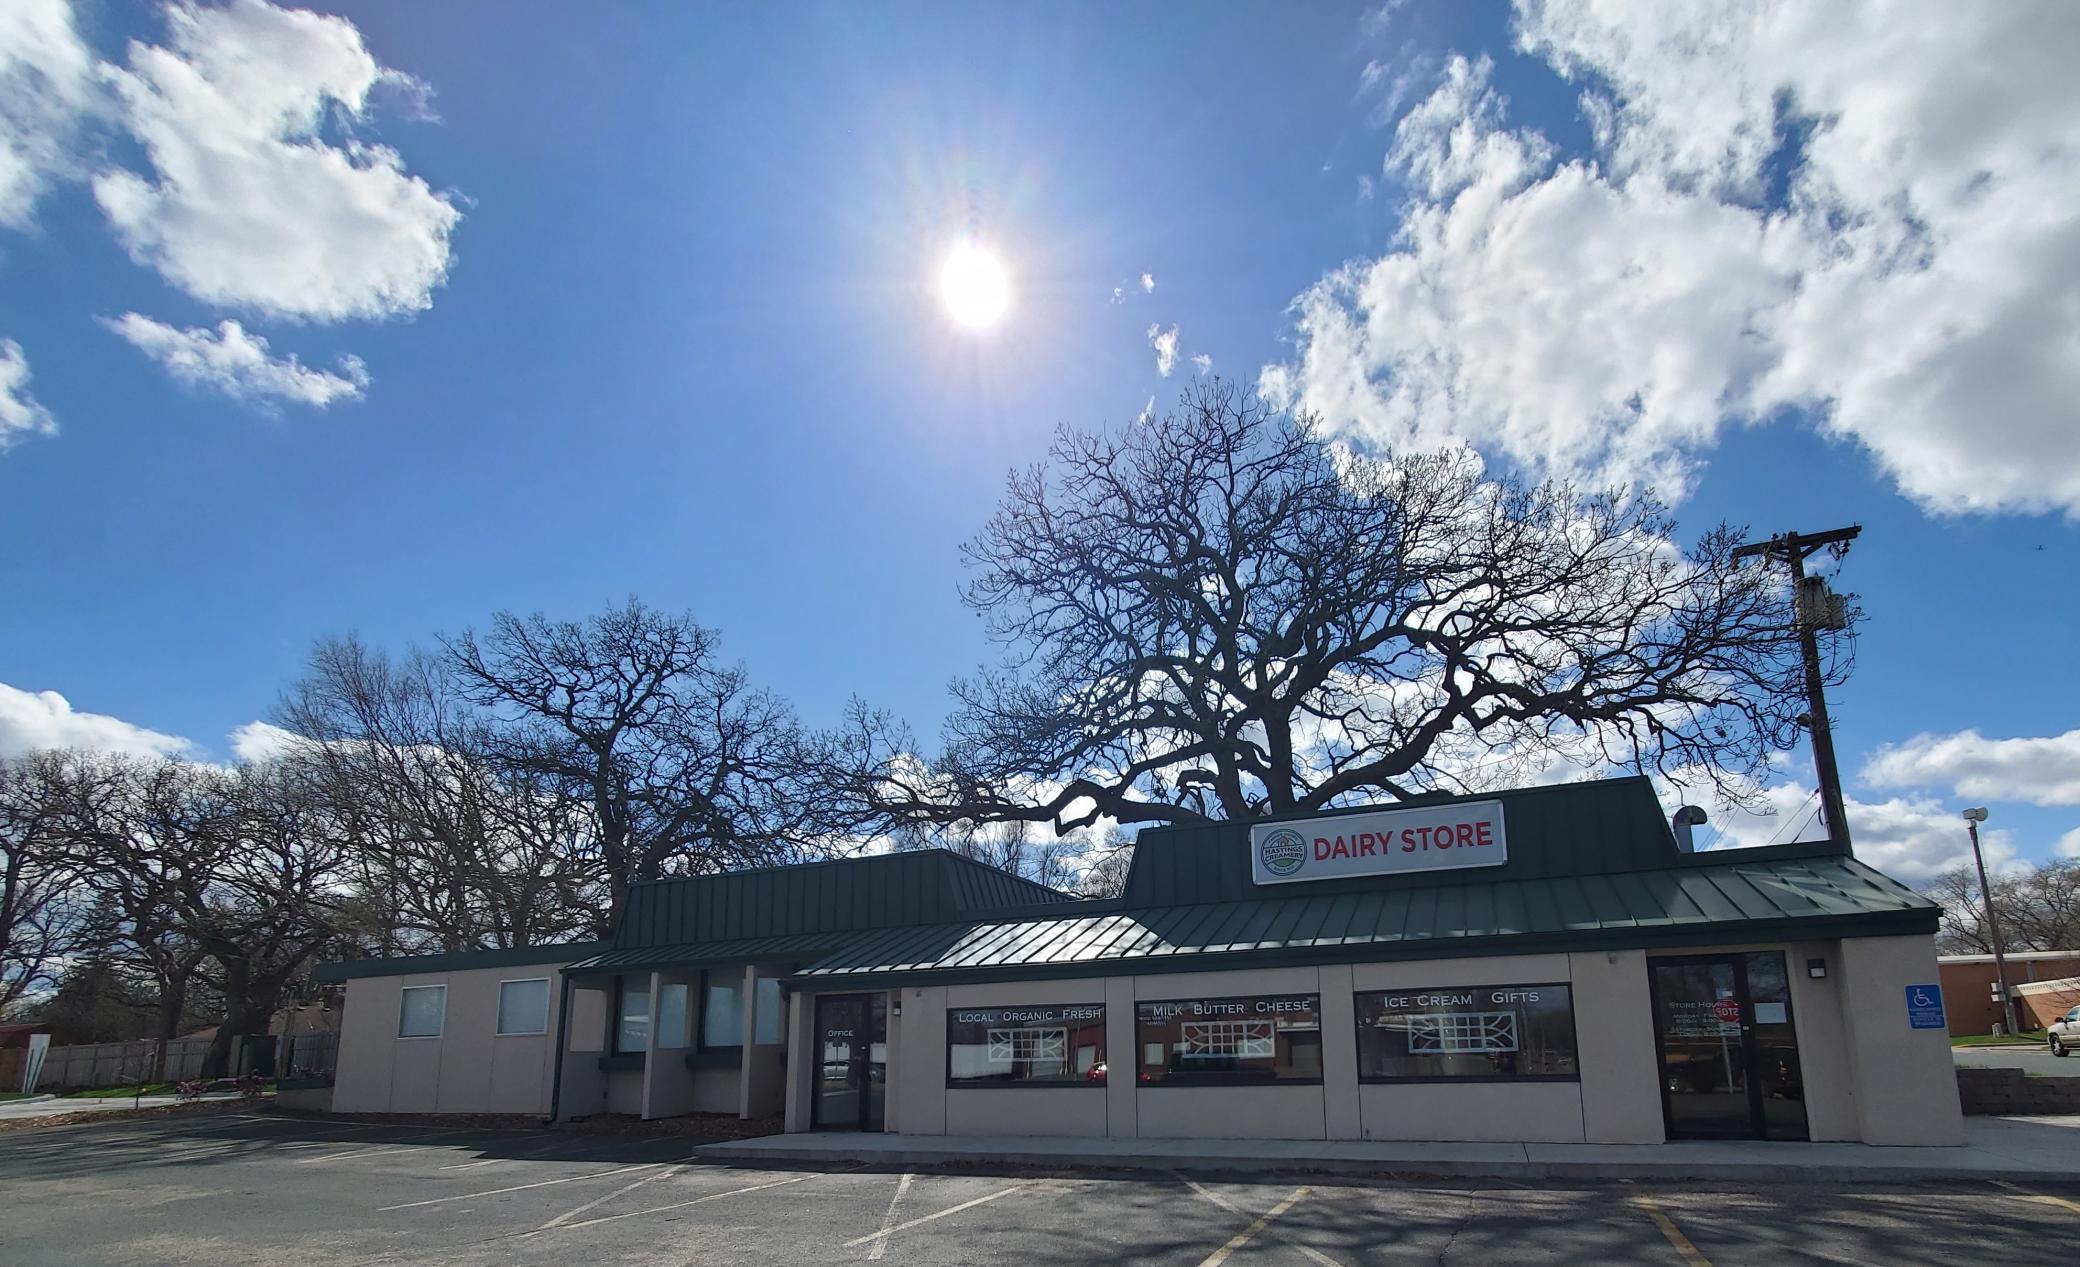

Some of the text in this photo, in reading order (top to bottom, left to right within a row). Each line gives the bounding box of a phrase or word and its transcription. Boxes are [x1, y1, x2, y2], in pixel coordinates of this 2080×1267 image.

[1313, 821, 1493, 861] DAIRY STORE
[1265, 846, 1303, 855] HASTINGS
[1265, 853, 1304, 862] CREAMERY
[1384, 992, 1540, 1008] ICE CREAM GIFTS
[1153, 1001, 1311, 1016] MILK BUTTER CHEESE
[959, 1009, 1101, 1023] LOCAL ORGANIC FRESH
[827, 1029, 854, 1037] OFFICE
